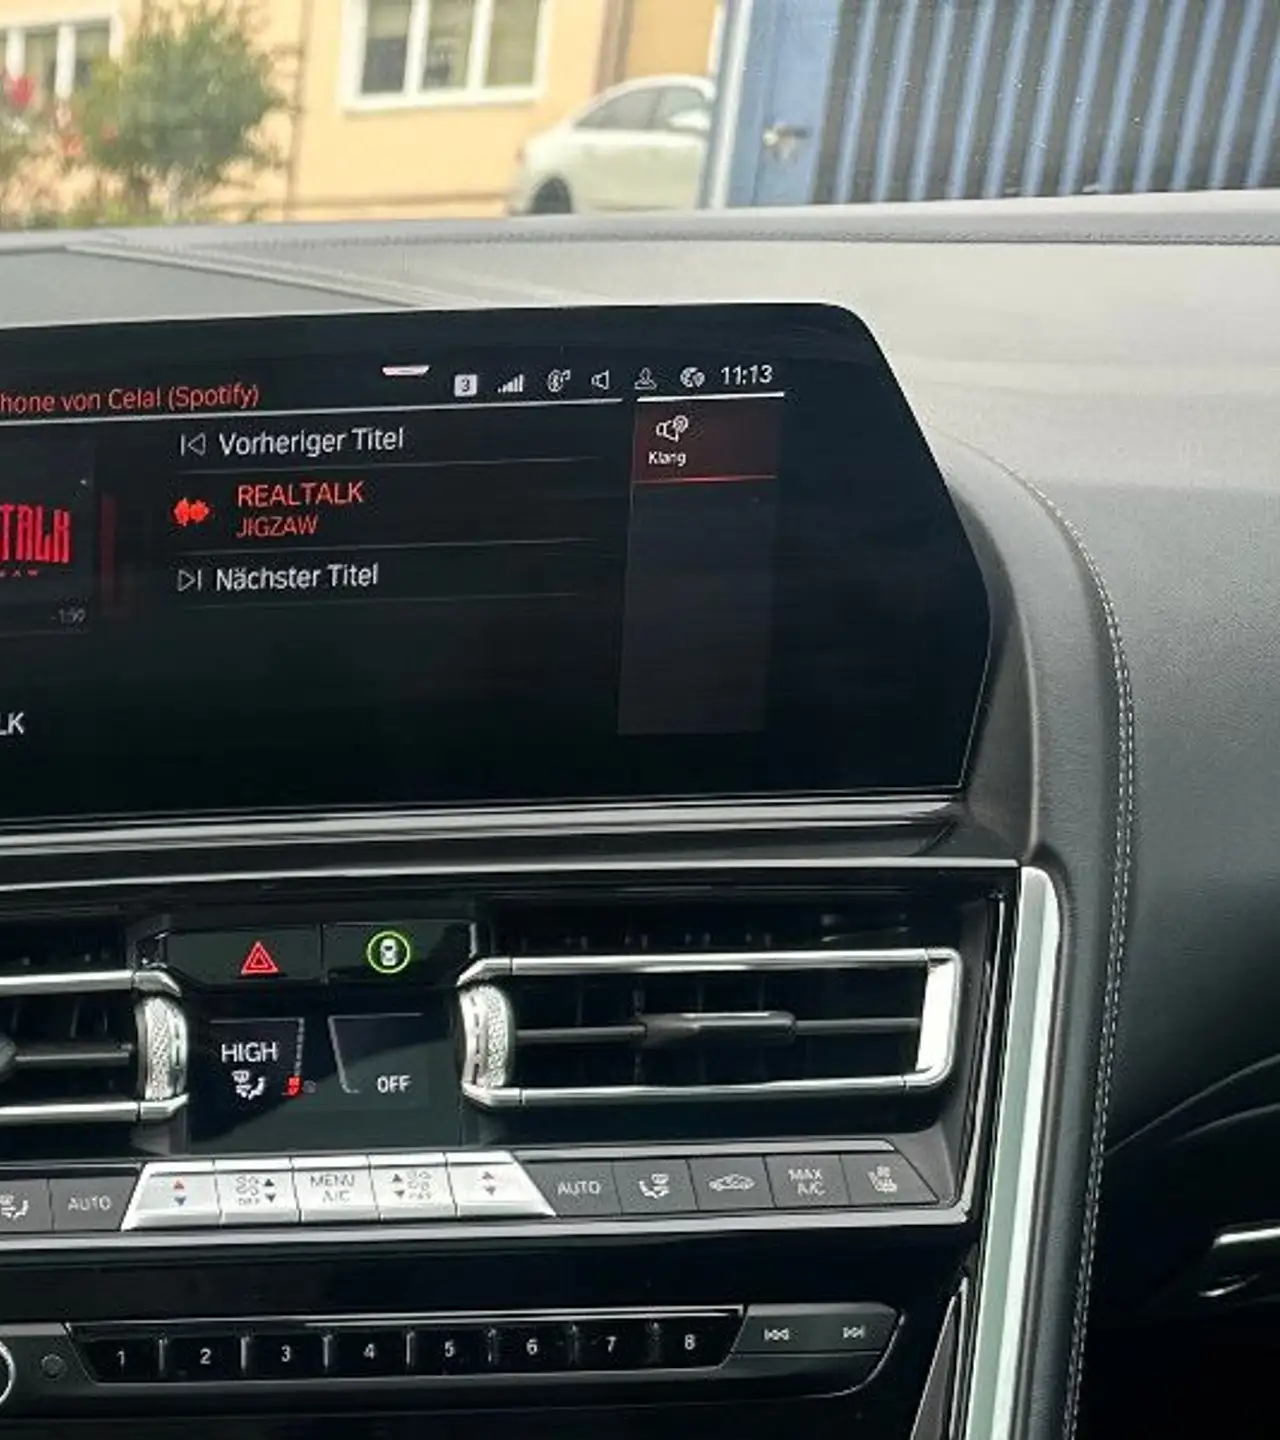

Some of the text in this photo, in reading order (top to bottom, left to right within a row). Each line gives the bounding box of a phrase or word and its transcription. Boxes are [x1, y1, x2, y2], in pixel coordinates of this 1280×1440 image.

[720, 365, 773, 386] 11:13
[61, 392, 101, 412] von
[169, 382, 260, 411] (Spotify)
[218, 427, 404, 457] Vorheriger Titel
[648, 450, 688, 468] Klang
[236, 481, 365, 508] REALTALK
[236, 515, 320, 538] JIGZAW
[215, 563, 379, 592] Nächster Titel
[220, 1041, 278, 1064] HIGH
[376, 1074, 411, 1094] OFF
[310, 1173, 356, 1188] MENU
[787, 1168, 824, 1182] MAX
[557, 1180, 602, 1197] AUTO
[67, 1195, 113, 1212] AUTO
[444, 1340, 457, 1358] 5
[526, 1338, 539, 1356] 6
[605, 1336, 616, 1353] 7
[684, 1333, 697, 1351] 8
[116, 1350, 126, 1366] 1
[199, 1348, 212, 1365] 2
[280, 1345, 292, 1362] 3
[363, 1343, 376, 1360] 4
